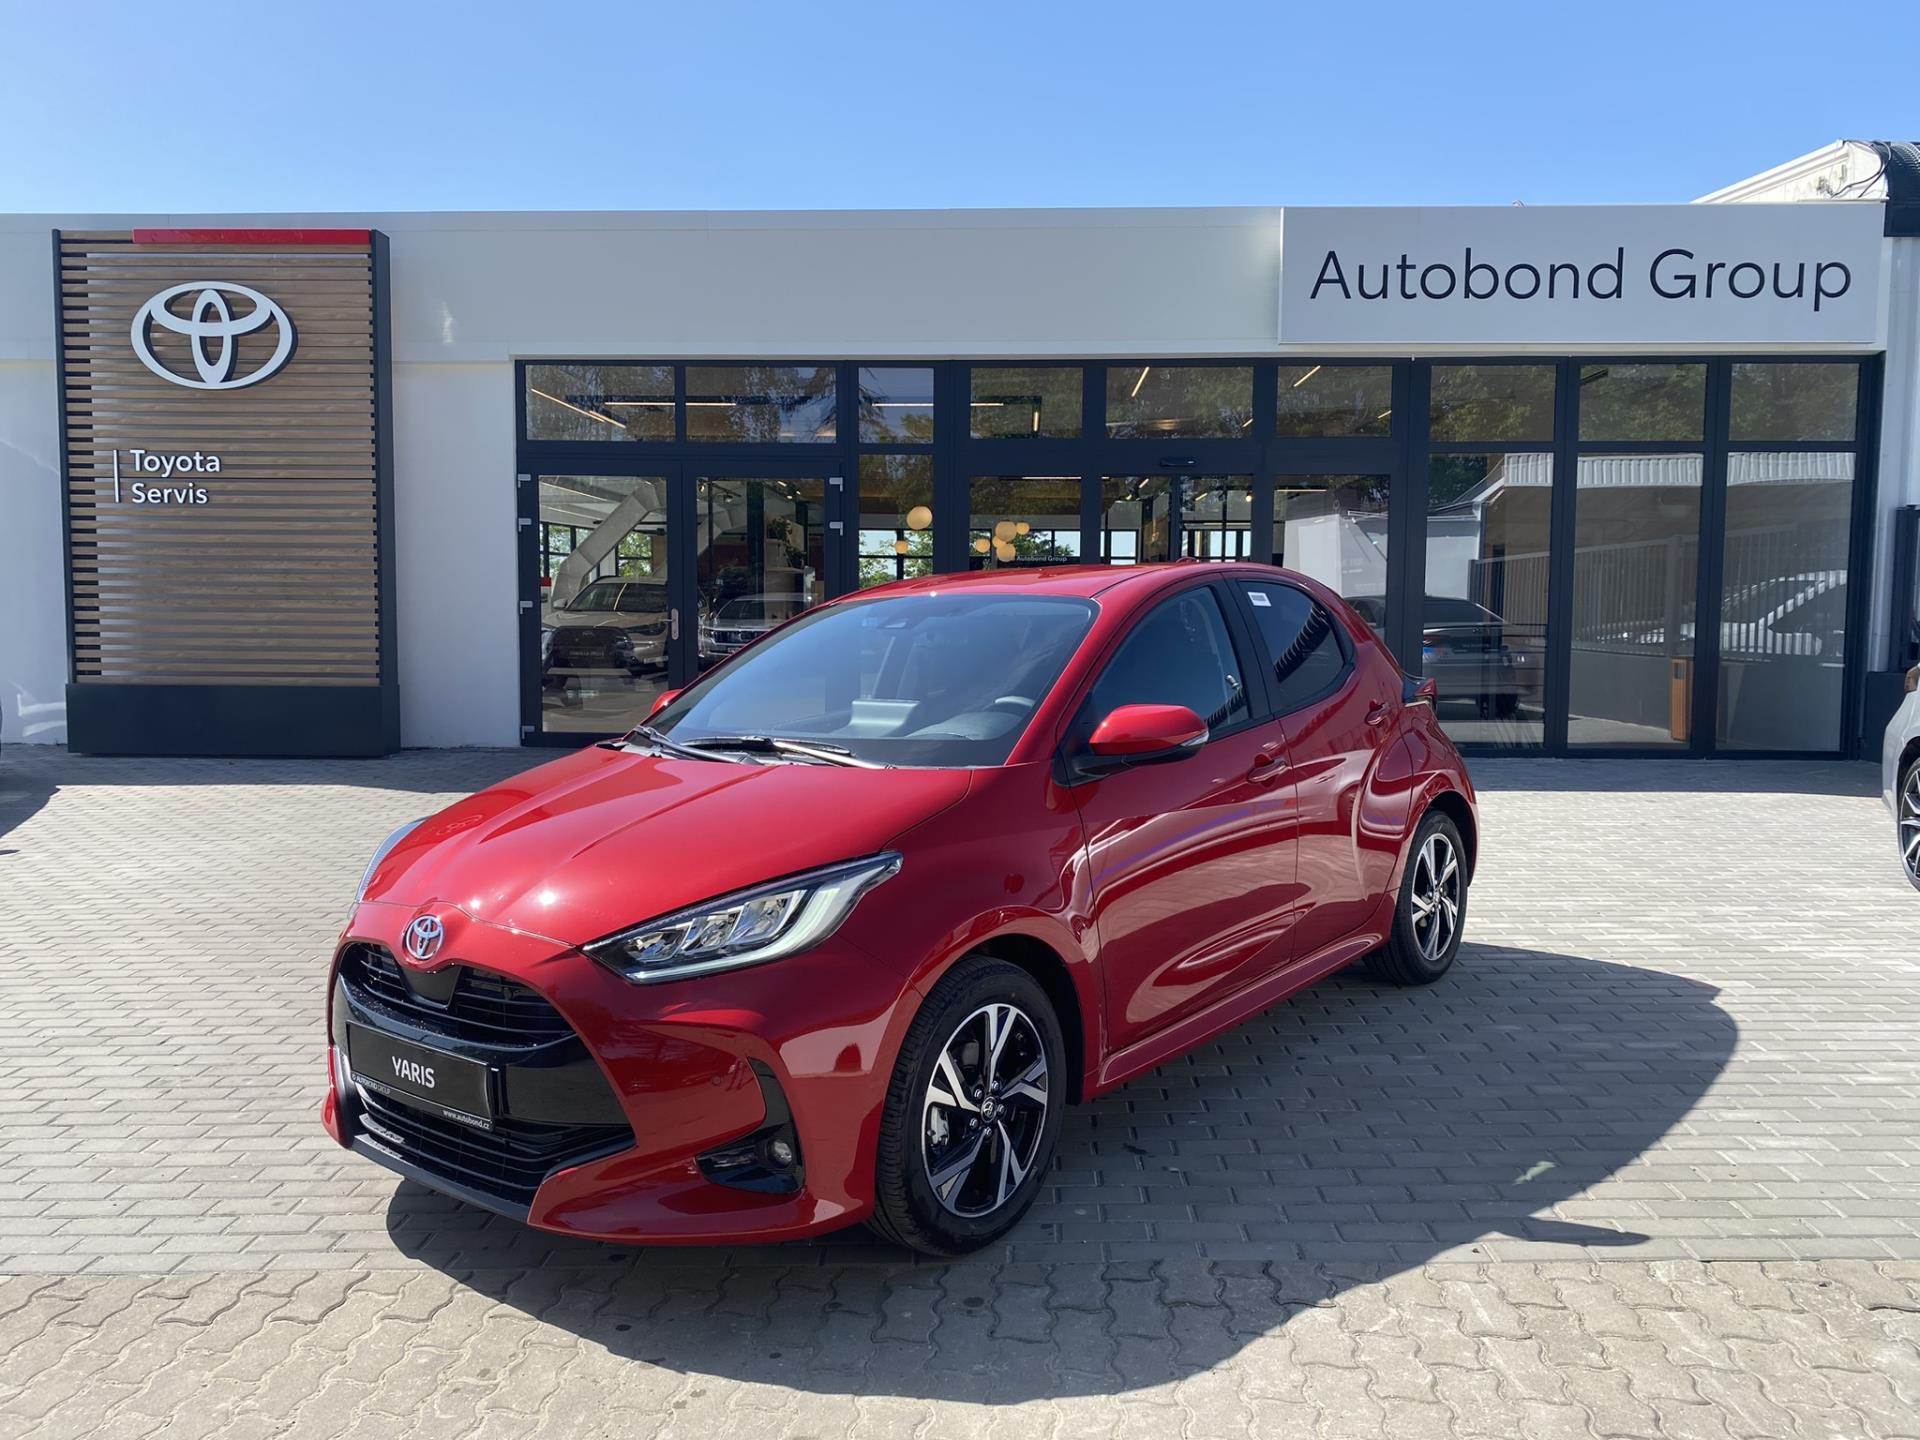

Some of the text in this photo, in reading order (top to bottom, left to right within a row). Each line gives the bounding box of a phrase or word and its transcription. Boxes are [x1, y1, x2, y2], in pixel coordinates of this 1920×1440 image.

[1309, 247, 1852, 312] Autobond Group
[129, 449, 221, 478] Toyota
[131, 482, 209, 504] Servis
[1016, 554, 1047, 562] Autobond
[391, 1055, 436, 1089] YARIS
[442, 1109, 491, 1130] www.autobond.cz
